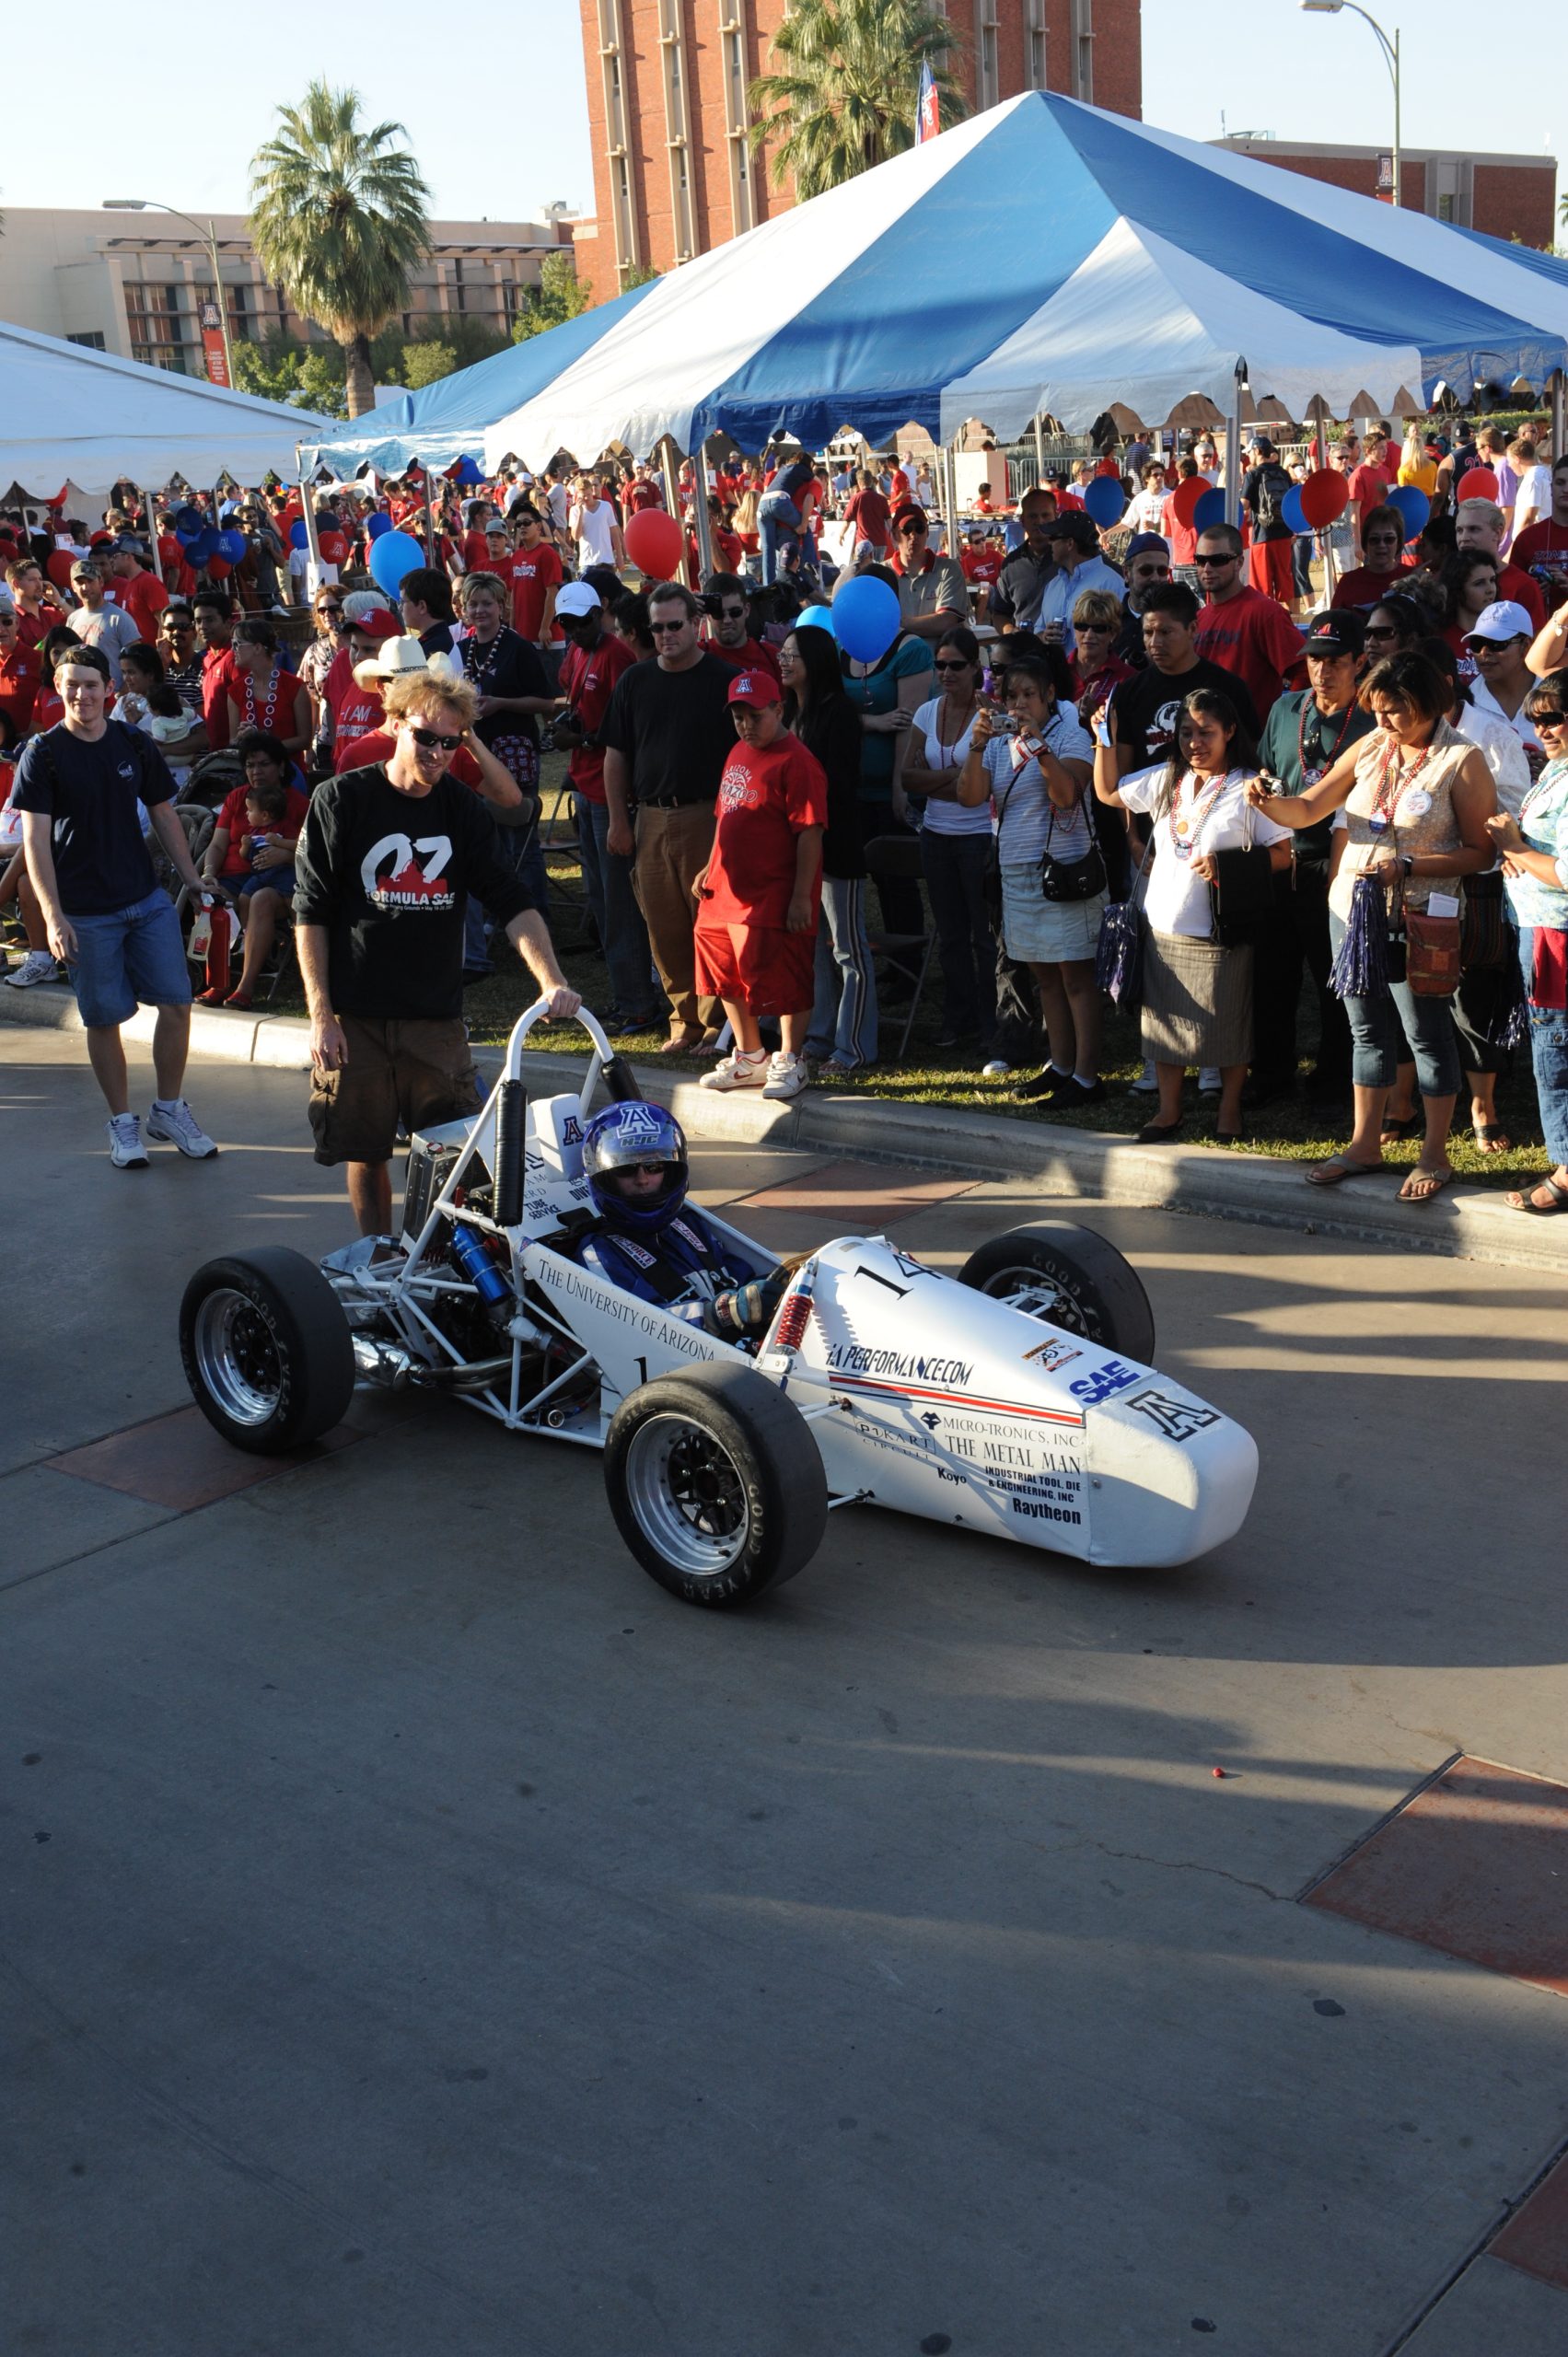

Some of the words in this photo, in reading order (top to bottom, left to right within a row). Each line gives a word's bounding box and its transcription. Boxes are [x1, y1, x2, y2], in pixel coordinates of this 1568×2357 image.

[736, 678, 753, 693] A
[563, 1116, 584, 1146] A
[616, 1105, 661, 1139] A
[621, 1134, 659, 1148] HJC
[523, 1198, 549, 1212] TUBE
[528, 1203, 563, 1221] SERVICE
[539, 1258, 563, 1288] THE
[566, 1272, 640, 1326] UNIVERSITY
[641, 1316, 658, 1334] OF
[656, 1322, 715, 1362] ARIZONA
[1069, 1360, 1142, 1404] SAE
[1125, 1389, 1223, 1443] A
[883, 1429, 932, 1448] KART
[945, 1434, 977, 1457] THE
[983, 1442, 1035, 1469] METAL
[1041, 1452, 1082, 1477] MAN
[936, 1467, 968, 1486] Koyo
[985, 1465, 1038, 1484] INDUSTRIAL
[1065, 1480, 1082, 1492] DIE
[1013, 1497, 1082, 1525] Raytheon
[1058, 1492, 1075, 1504] INC
